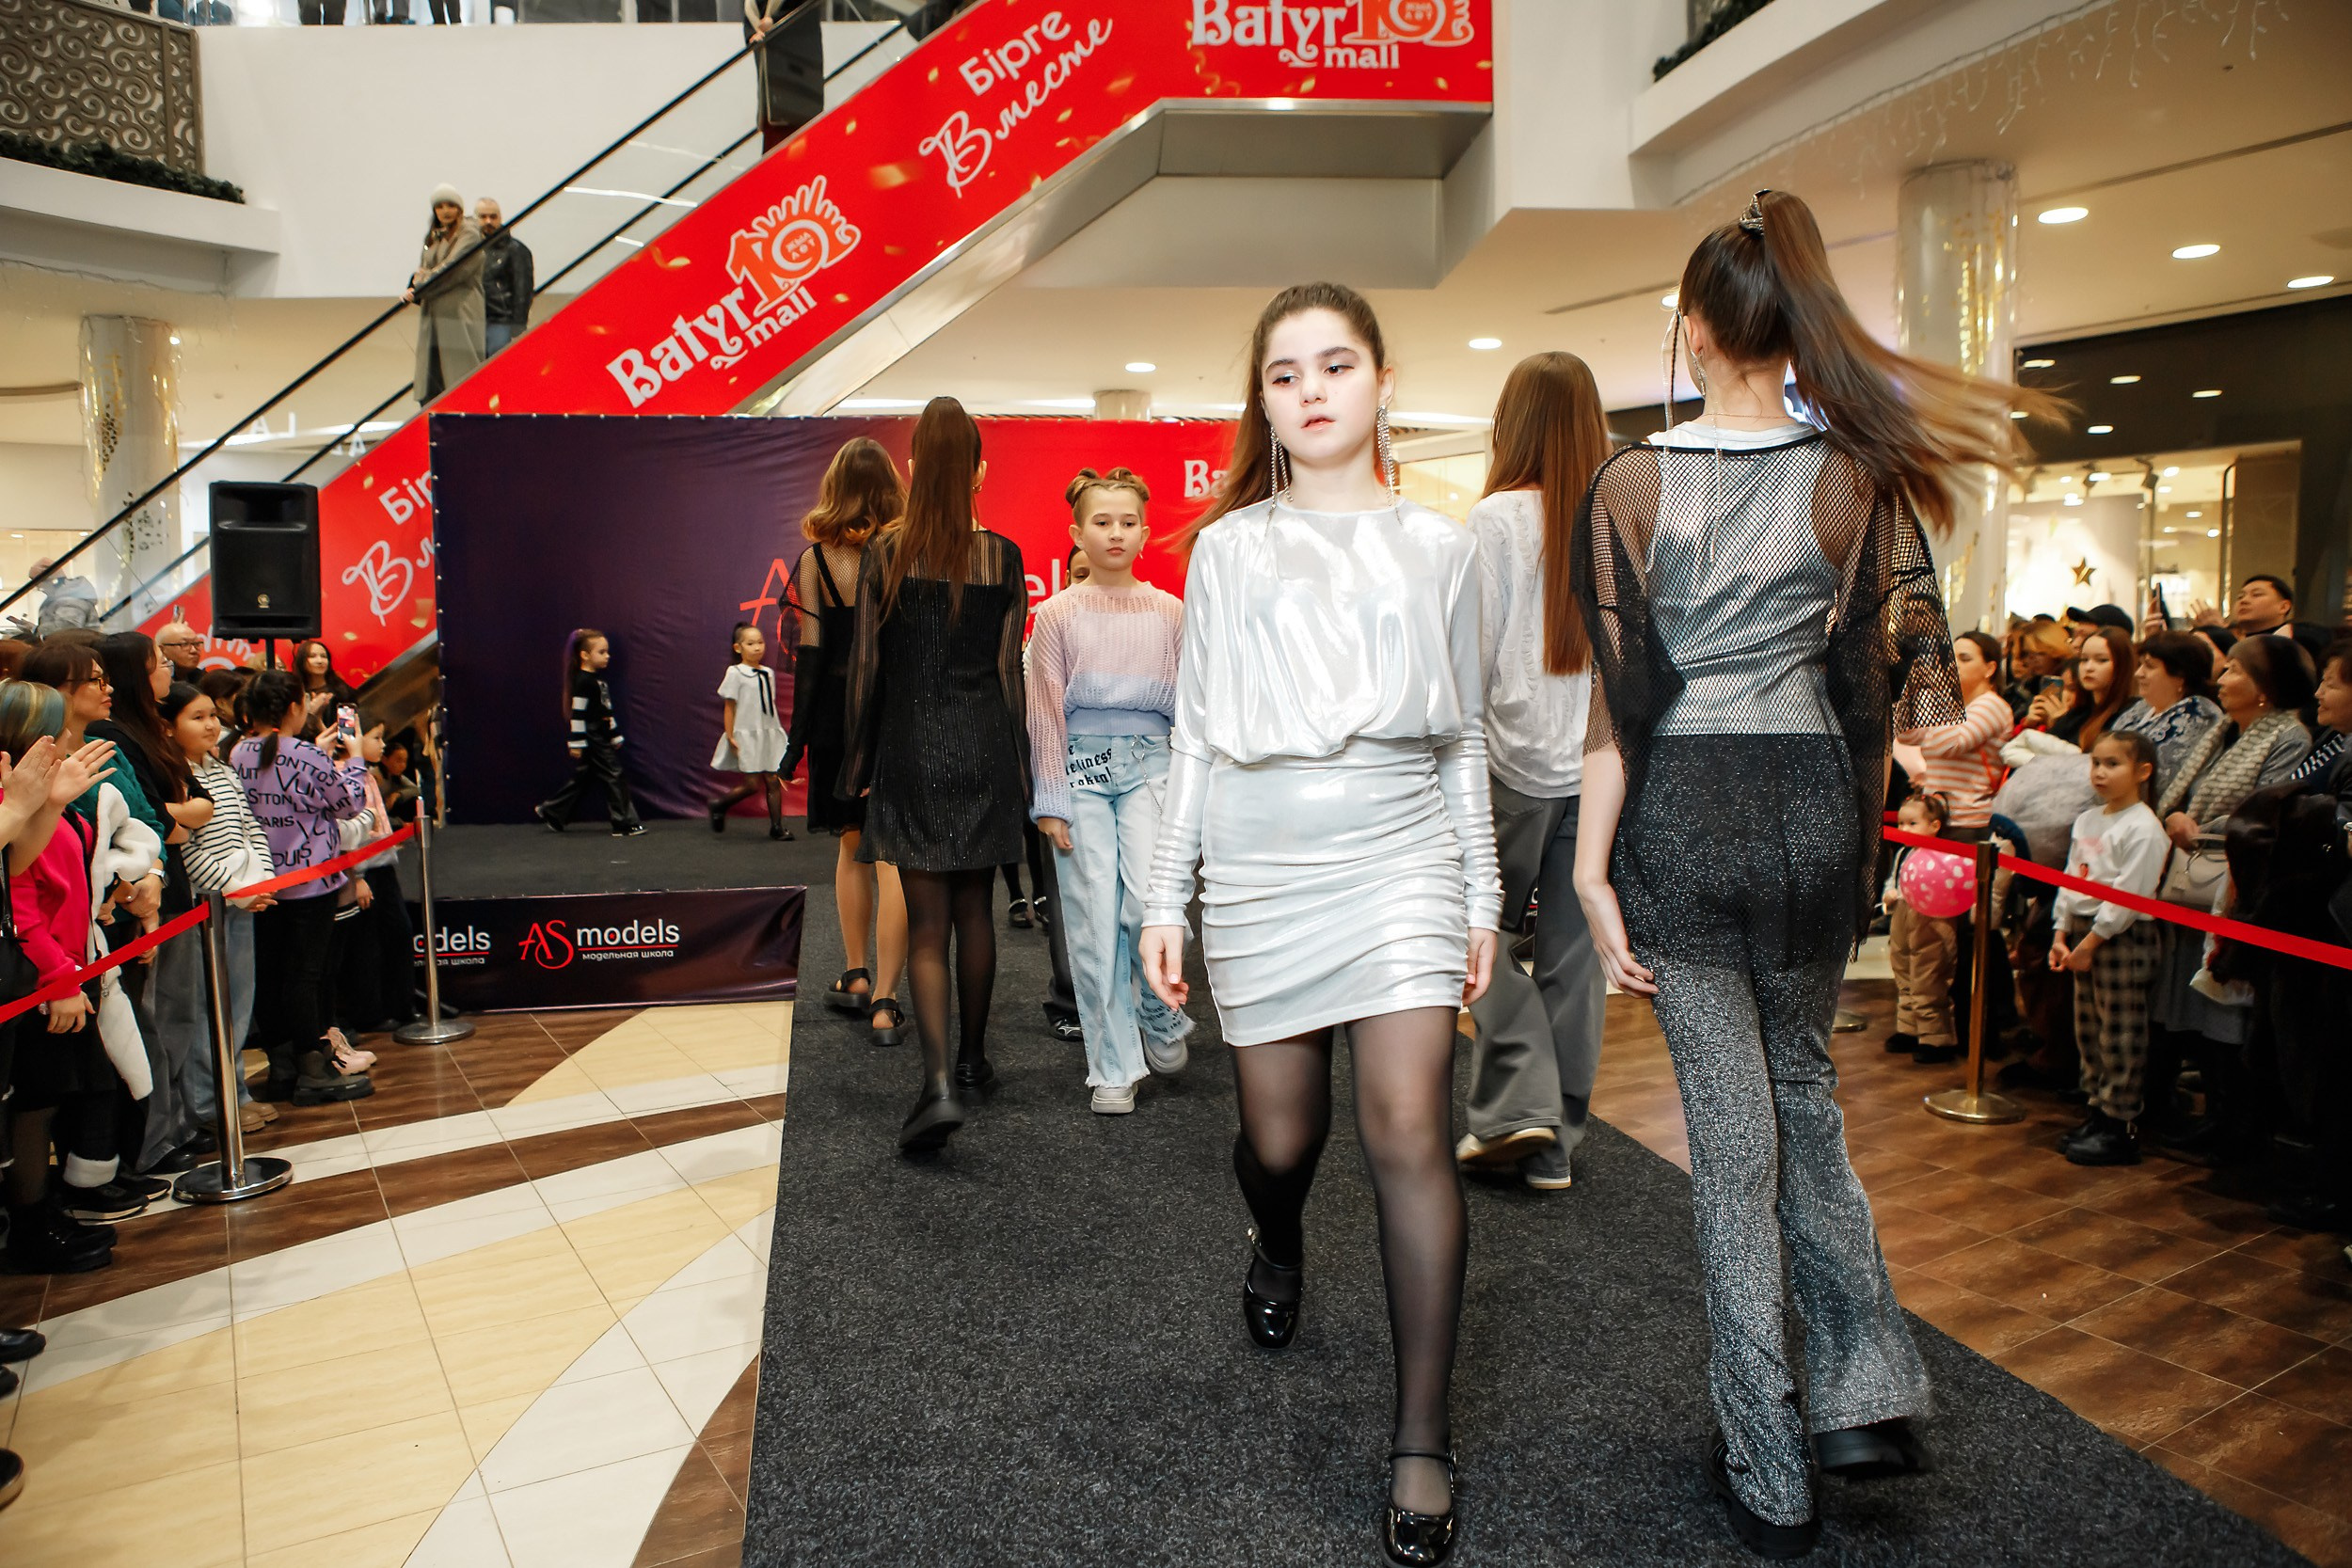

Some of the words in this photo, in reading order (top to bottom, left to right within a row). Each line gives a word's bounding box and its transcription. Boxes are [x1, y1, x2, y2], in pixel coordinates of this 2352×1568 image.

[958, 11, 1071, 96] Бірге
[1324, 44, 1400, 69] mall
[918, 19, 1113, 198] Вместе
[606, 286, 752, 408] Batyr
[745, 286, 818, 348] mall
[518, 919, 575, 970] AS
[577, 918, 680, 946] models
[582, 951, 639, 961] модельная
[641, 950, 675, 958] школа
